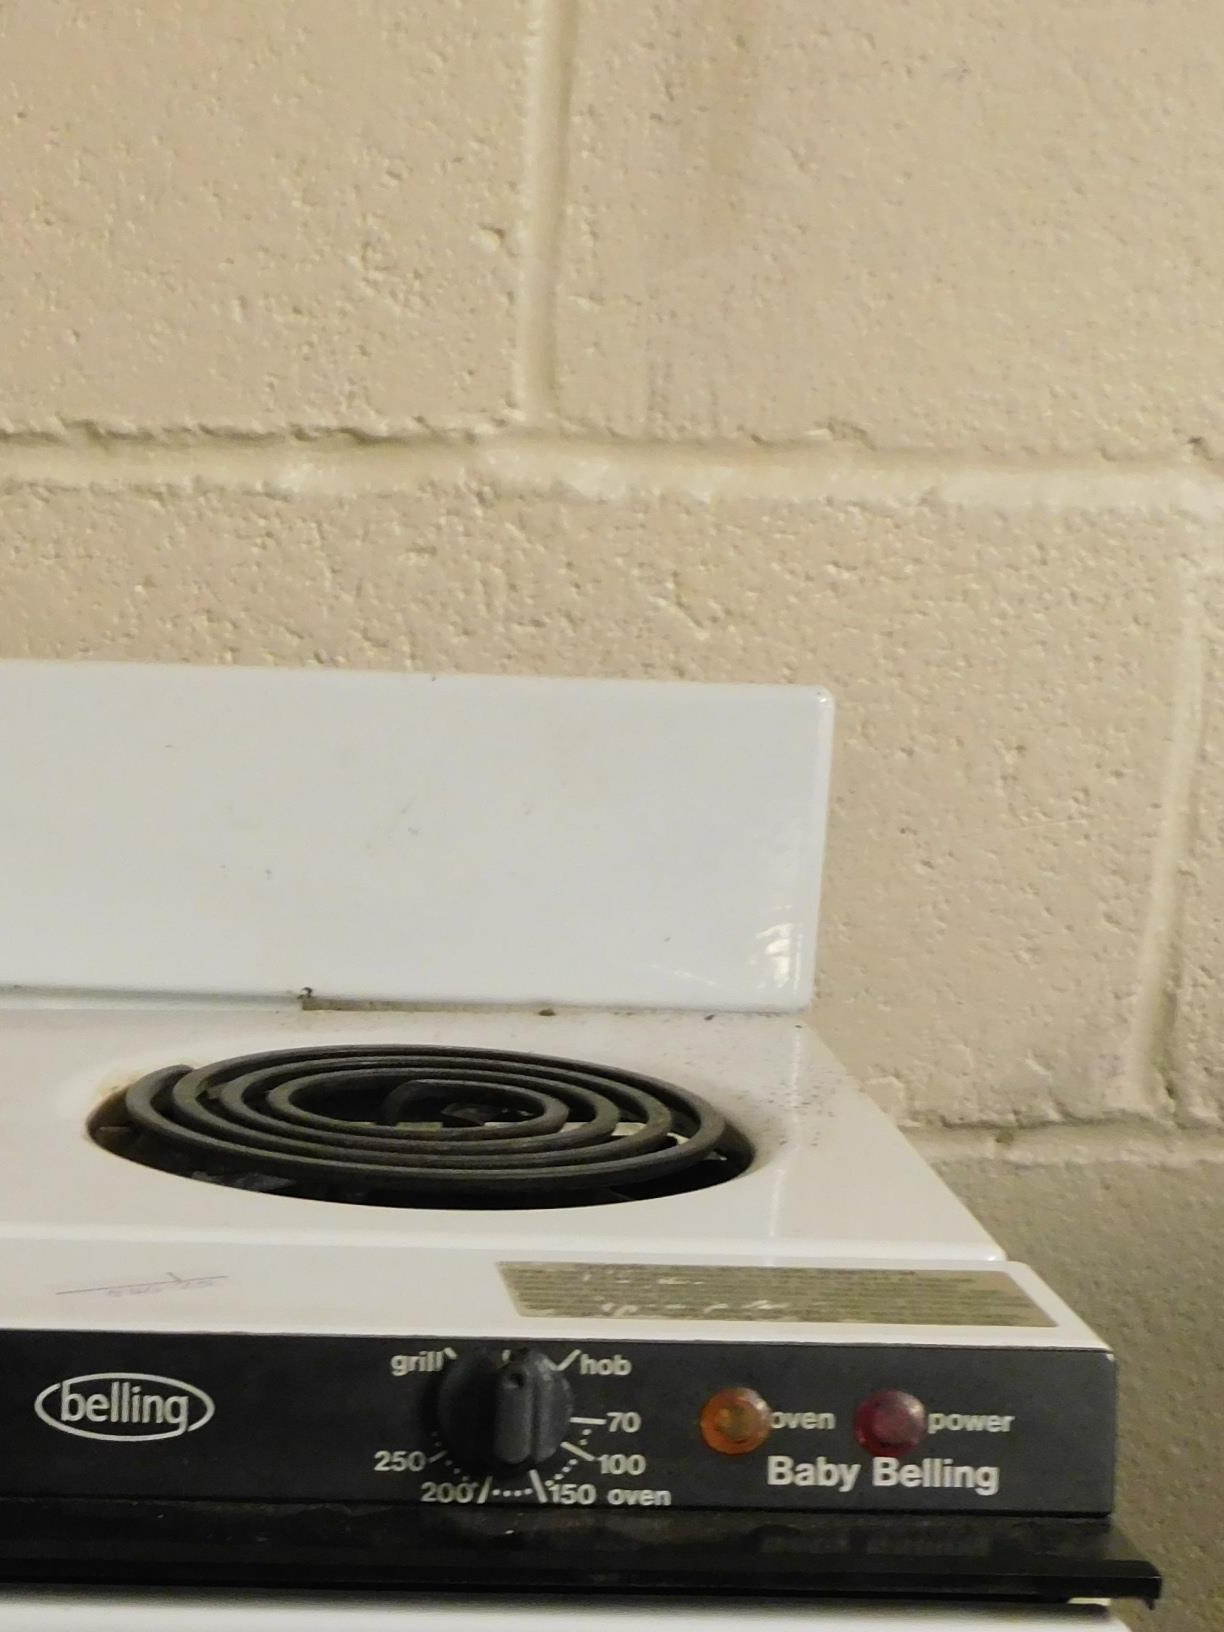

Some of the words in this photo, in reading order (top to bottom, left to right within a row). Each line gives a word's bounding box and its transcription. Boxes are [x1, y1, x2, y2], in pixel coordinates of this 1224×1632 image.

[390, 1350, 444, 1376] grill
[579, 1353, 632, 1376] hob
[59, 1381, 190, 1434] belling
[607, 1411, 642, 1433] 70
[770, 1409, 836, 1430] oven
[927, 1411, 1015, 1434] power
[373, 1450, 426, 1472] 250
[598, 1453, 647, 1476] 100
[766, 1455, 862, 1492] Baby
[872, 1456, 1000, 1496] Belling
[421, 1482, 474, 1503] 200
[549, 1484, 597, 1505] 150
[607, 1488, 672, 1507] oven
